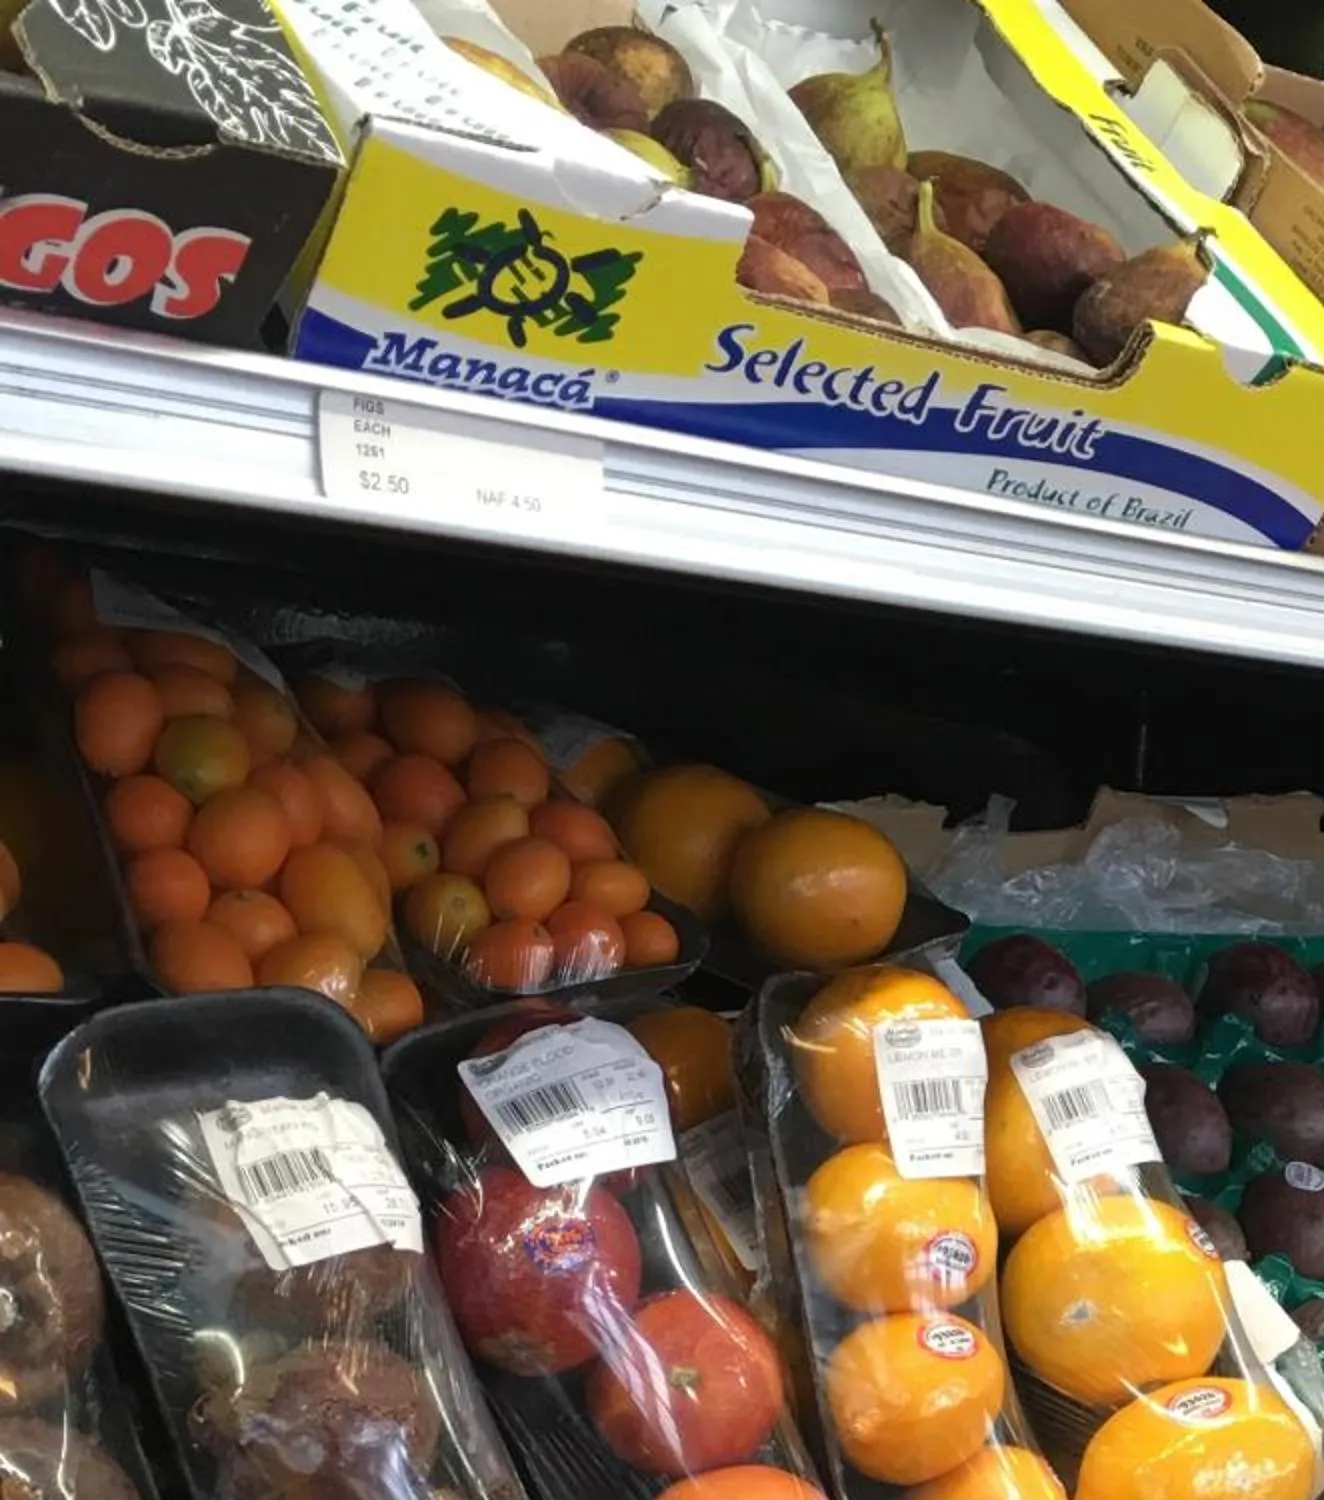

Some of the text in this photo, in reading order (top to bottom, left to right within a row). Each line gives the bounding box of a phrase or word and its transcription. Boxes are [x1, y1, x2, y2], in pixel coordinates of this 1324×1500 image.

[1088, 113, 1156, 172] Fruit
[373, 331, 595, 402] Manacá
[705, 323, 1107, 458] Selected Fruit
[353, 398, 385, 415] FIGS
[354, 419, 391, 437] EACH
[987, 468, 1195, 529] Product of Brazil
